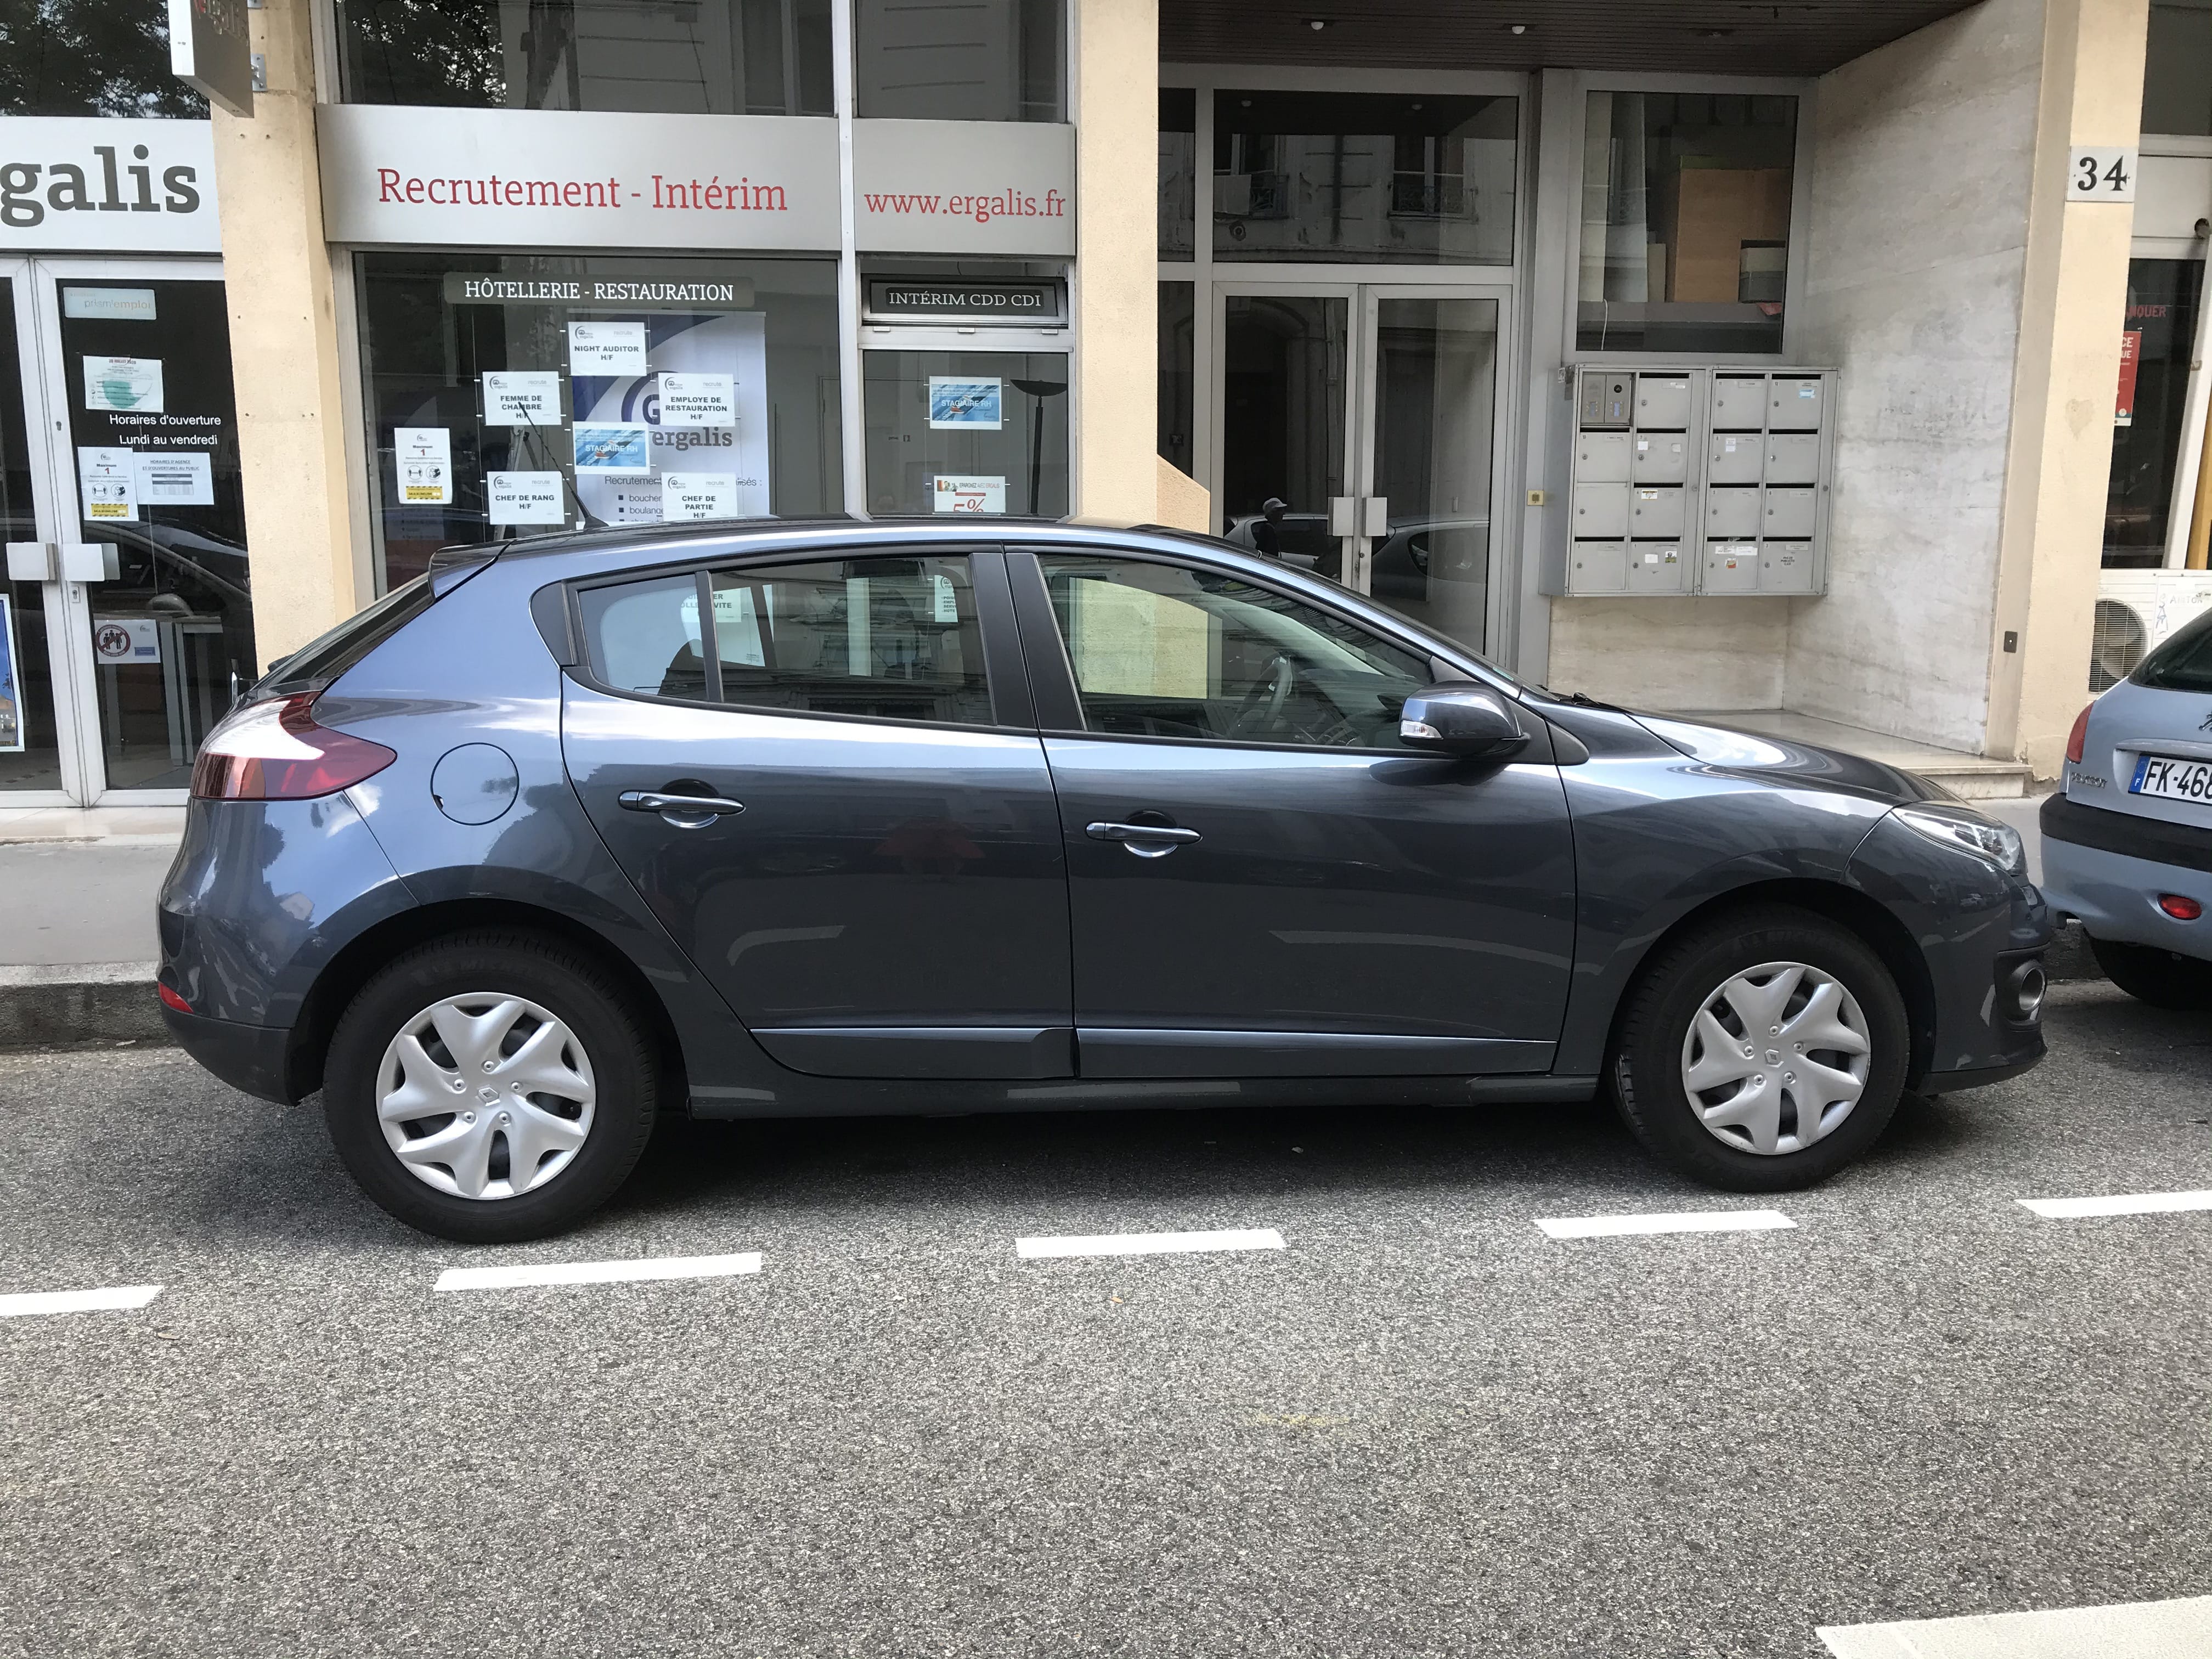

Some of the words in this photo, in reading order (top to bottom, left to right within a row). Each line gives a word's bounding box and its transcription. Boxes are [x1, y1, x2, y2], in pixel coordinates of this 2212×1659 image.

[2078, 155, 2128, 191] 34
[0, 144, 201, 227] galis
[377, 168, 621, 208] Recrutement
[651, 175, 788, 211] Intérim
[864, 188, 1066, 223] www.ergalis.fr
[465, 277, 580, 299] HÔTELLERIE
[594, 283, 734, 301] RESTAURATION
[888, 290, 966, 306] INTÉRIM
[969, 294, 1006, 307] CDD
[1011, 295, 1041, 307] CDI
[110, 415, 157, 425] Horaires
[160, 415, 221, 426] d'ouverture
[119, 434, 150, 445] Lundi
[170, 435, 218, 445] vendredi
[651, 427, 733, 451] ergalis
[2134, 778, 2141, 787] F
